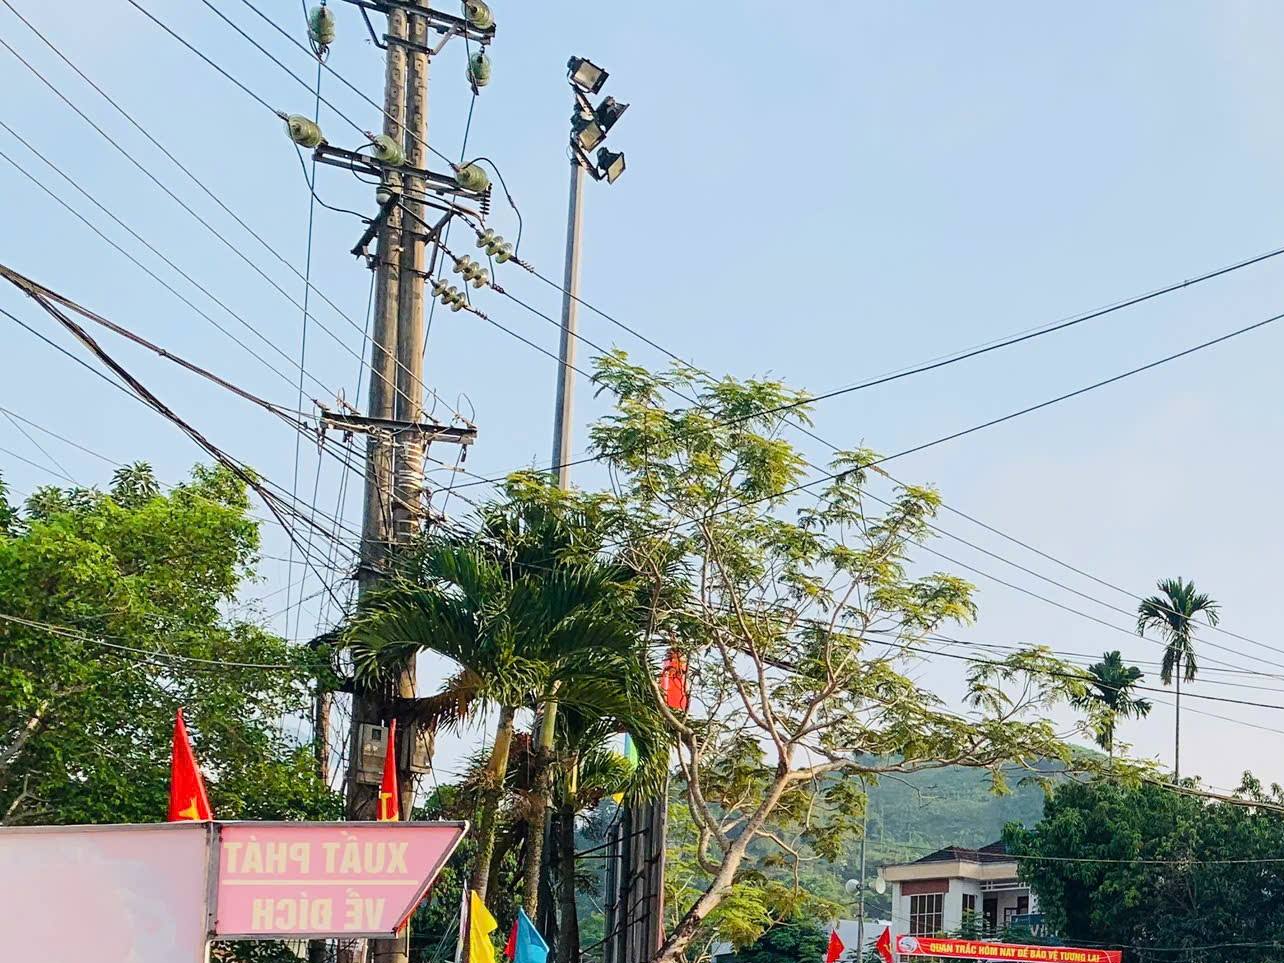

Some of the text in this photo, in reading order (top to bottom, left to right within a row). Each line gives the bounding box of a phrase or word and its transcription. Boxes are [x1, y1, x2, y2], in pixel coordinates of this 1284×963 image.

[930, 943, 952, 954] QUAN
[955, 943, 977, 955] TRẮC
[978, 945, 998, 956] HÔM
[999, 947, 1016, 957] NAY
[1060, 950, 1086, 962] TƯƠNG
[1088, 953, 1100, 963] LAI
